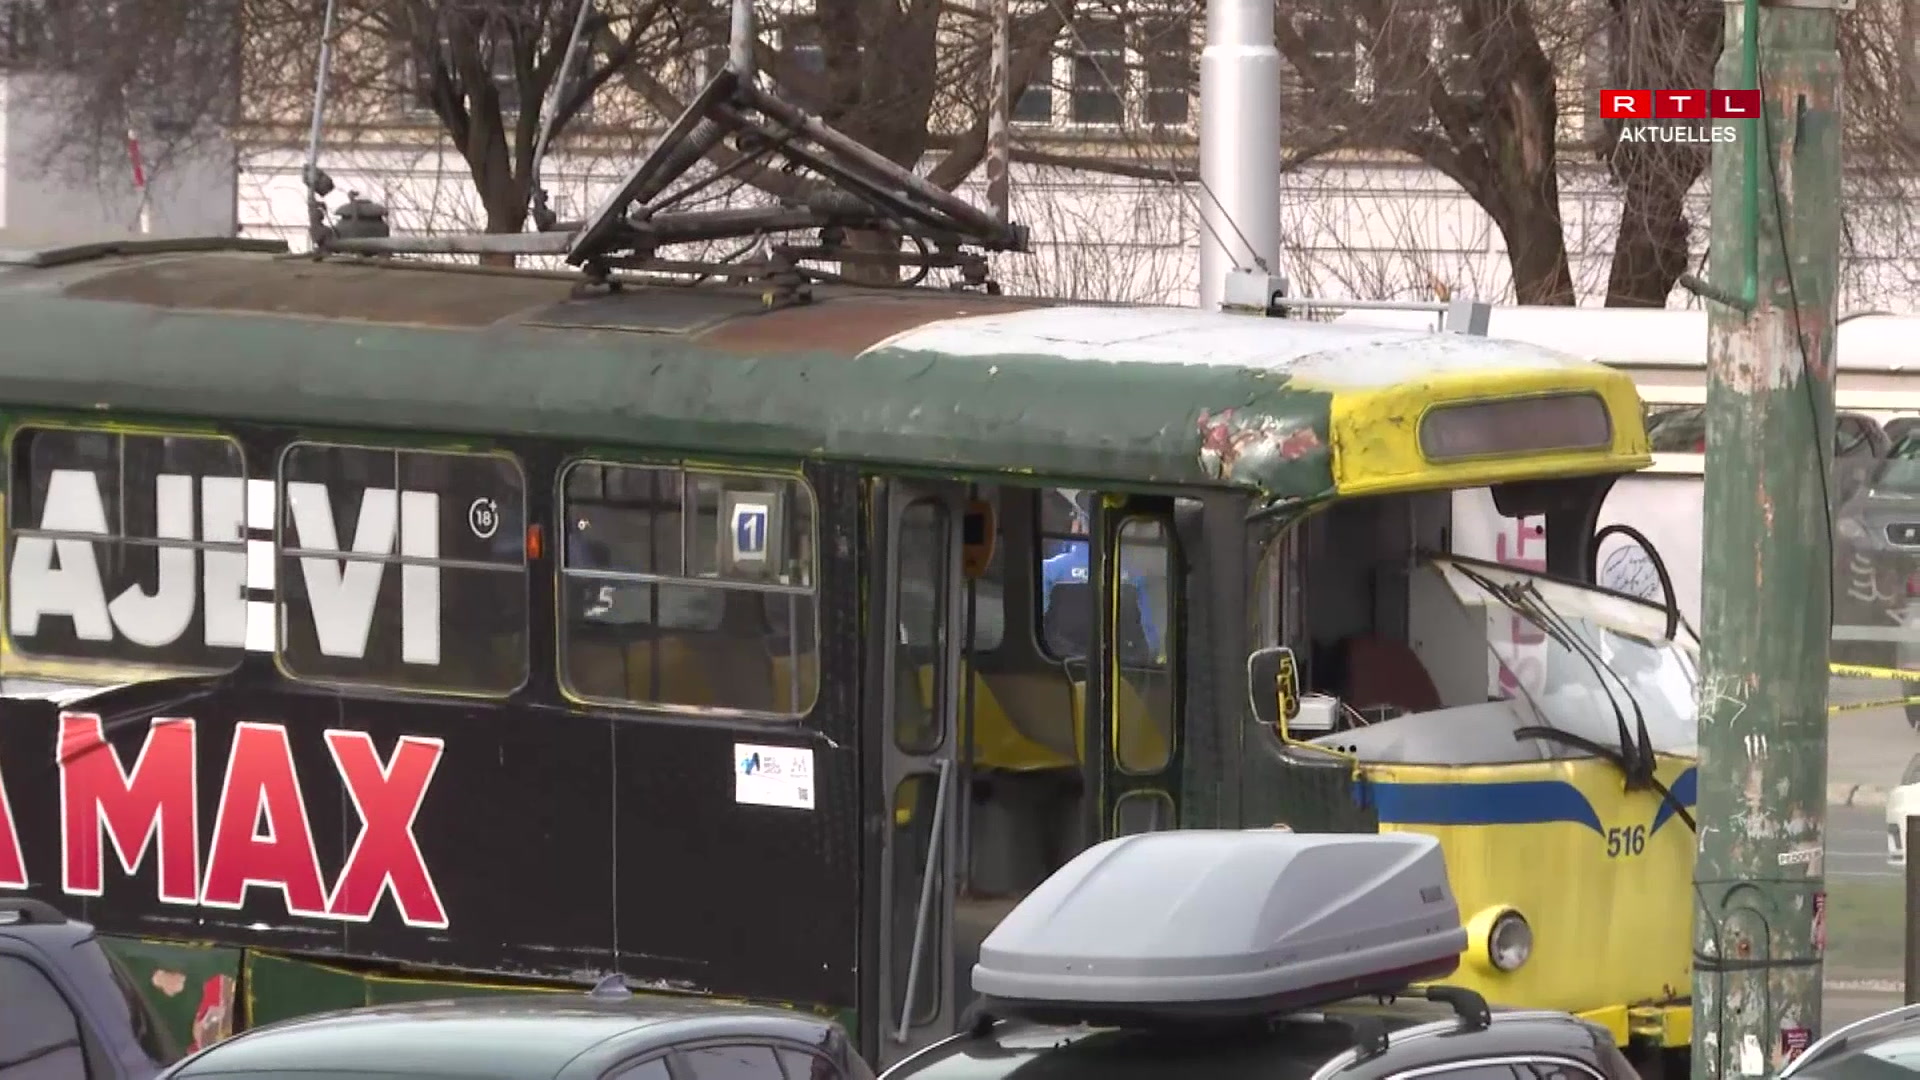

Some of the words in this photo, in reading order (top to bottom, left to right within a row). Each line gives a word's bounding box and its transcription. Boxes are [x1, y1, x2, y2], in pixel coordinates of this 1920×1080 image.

[10, 470, 441, 664] AJEVI
[743, 514, 758, 550] 1
[56, 711, 449, 929] MAX
[1607, 823, 1645, 858] 516
